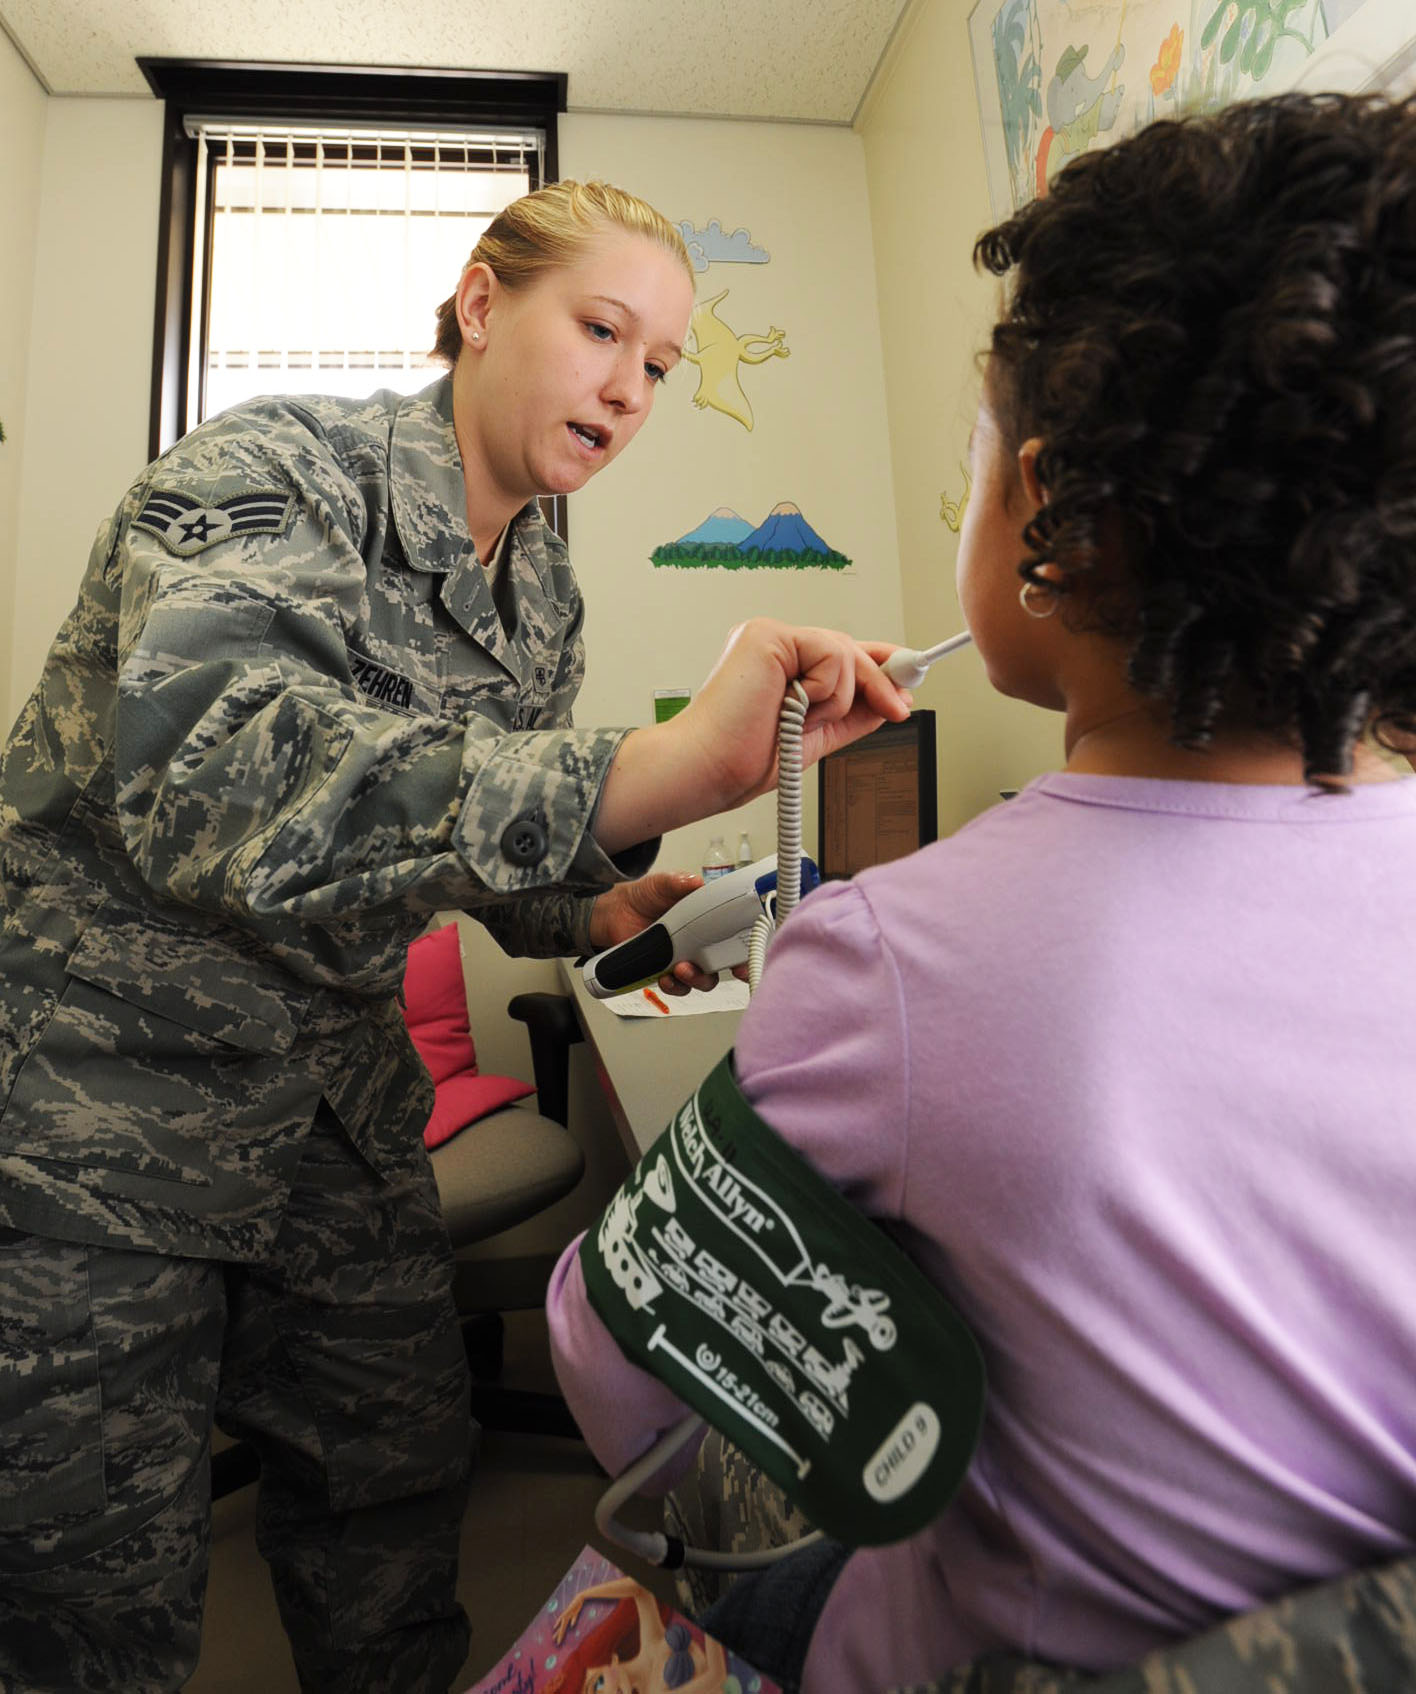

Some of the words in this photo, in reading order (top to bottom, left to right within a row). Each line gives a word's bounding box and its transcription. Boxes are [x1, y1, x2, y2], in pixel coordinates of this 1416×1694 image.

[352, 659, 413, 709] ZEHREN
[679, 1098, 707, 1180] Welch
[701, 1163, 766, 1234] Allyn
[874, 1429, 916, 1488] CHILD
